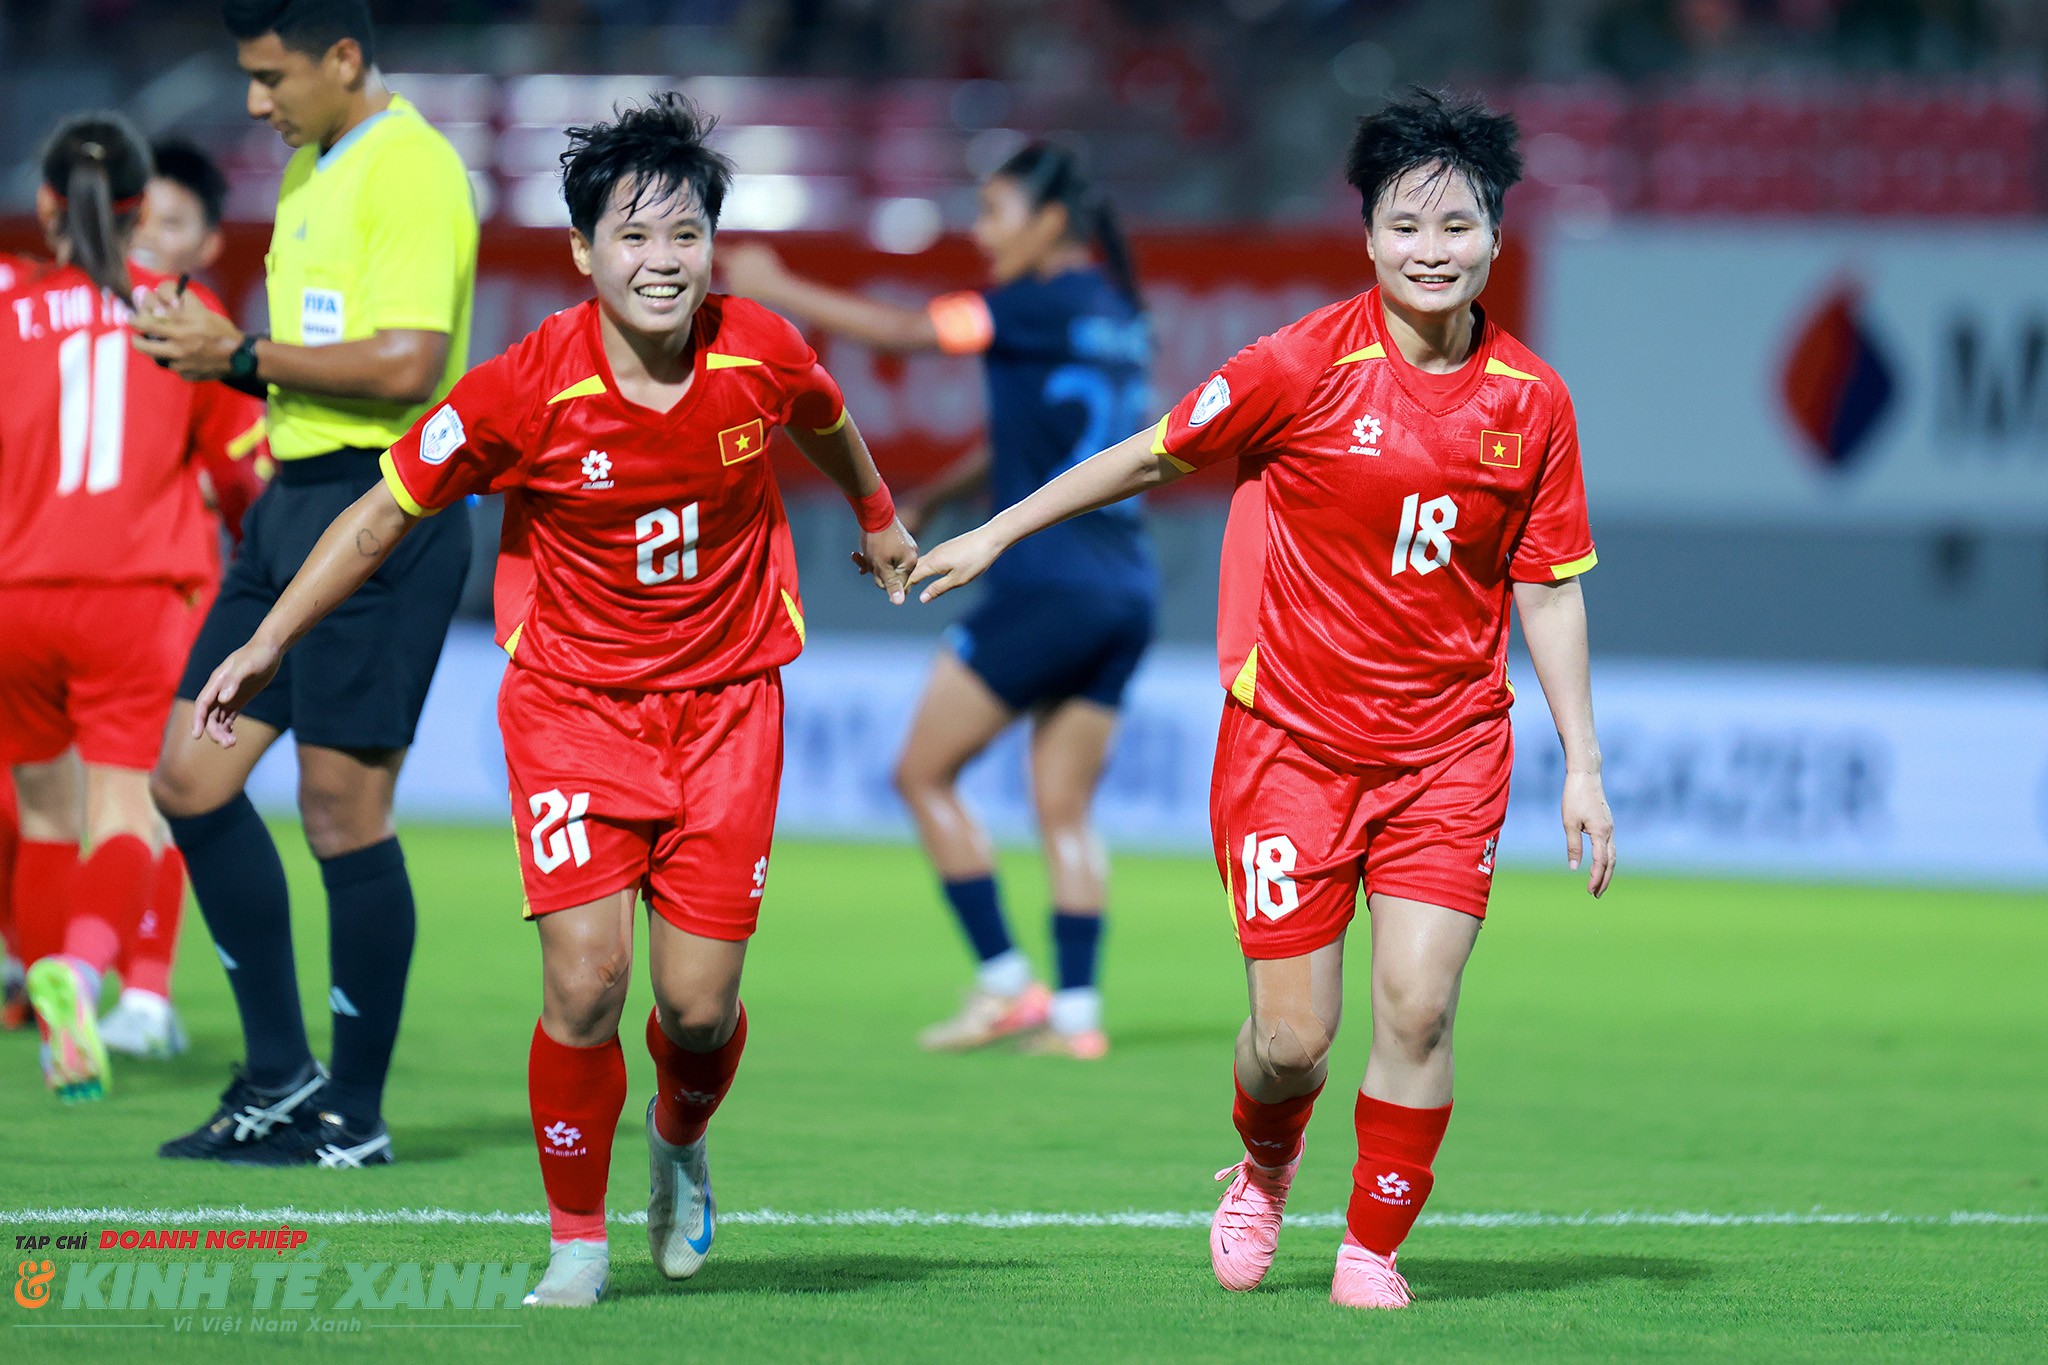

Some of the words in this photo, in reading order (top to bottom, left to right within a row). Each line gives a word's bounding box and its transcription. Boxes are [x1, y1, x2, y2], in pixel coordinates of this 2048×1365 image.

[305, 294, 337, 313] FIFA
[56, 327, 128, 496] 11
[635, 501, 699, 586] 21
[1391, 492, 1458, 577] 18
[529, 788, 591, 875] 21
[1241, 831, 1300, 922] 18
